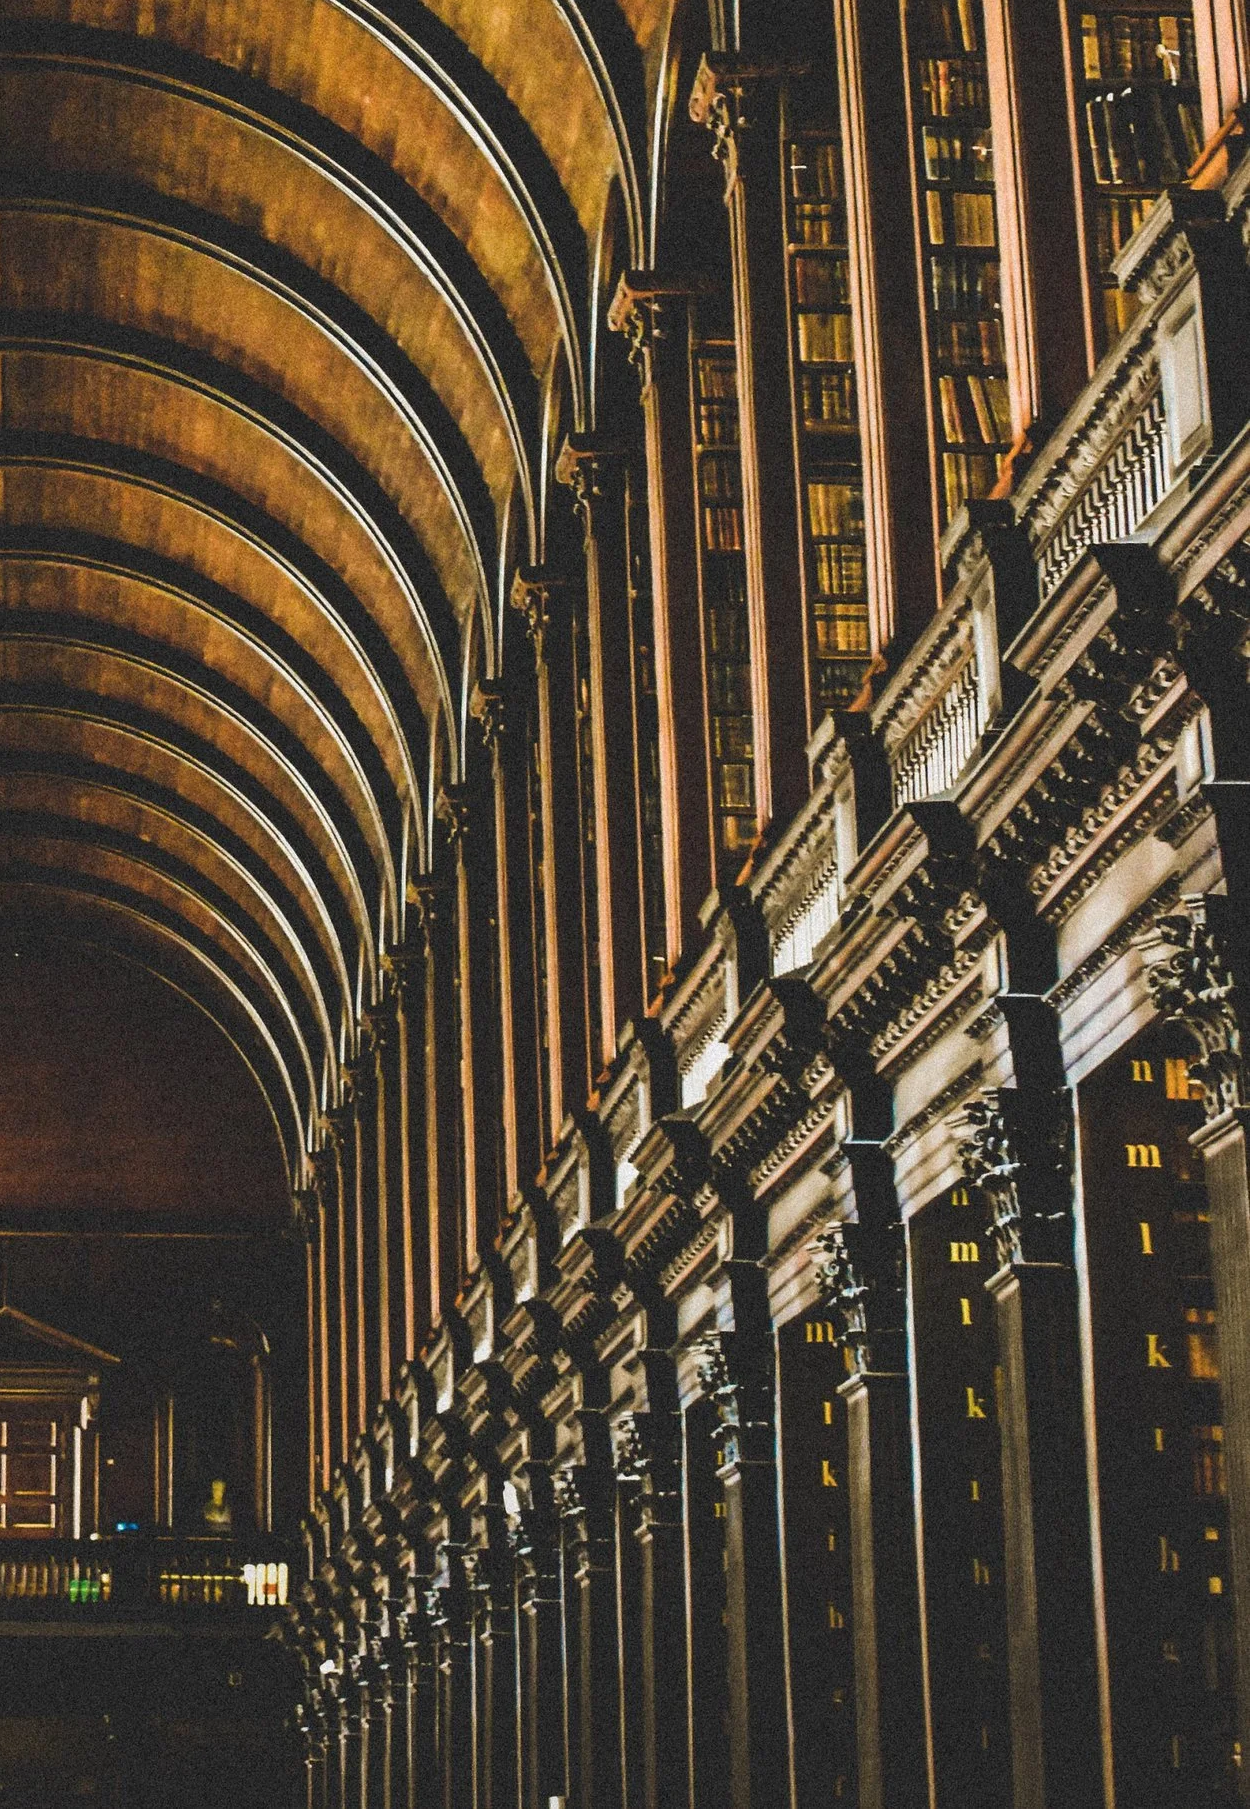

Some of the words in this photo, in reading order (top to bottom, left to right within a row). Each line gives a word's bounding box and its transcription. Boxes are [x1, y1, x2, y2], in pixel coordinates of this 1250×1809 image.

[1132, 1060, 1153, 1082] n
[1125, 1144, 1162, 1168] m
[950, 1241, 979, 1262] m
[1140, 1222, 1153, 1255] l
[960, 1298, 972, 1325] l
[805, 1321, 835, 1344] m
[1147, 1334, 1171, 1368] k
[965, 1387, 986, 1419] k
[821, 1459, 839, 1487] k
[1160, 1536, 1179, 1572] h
